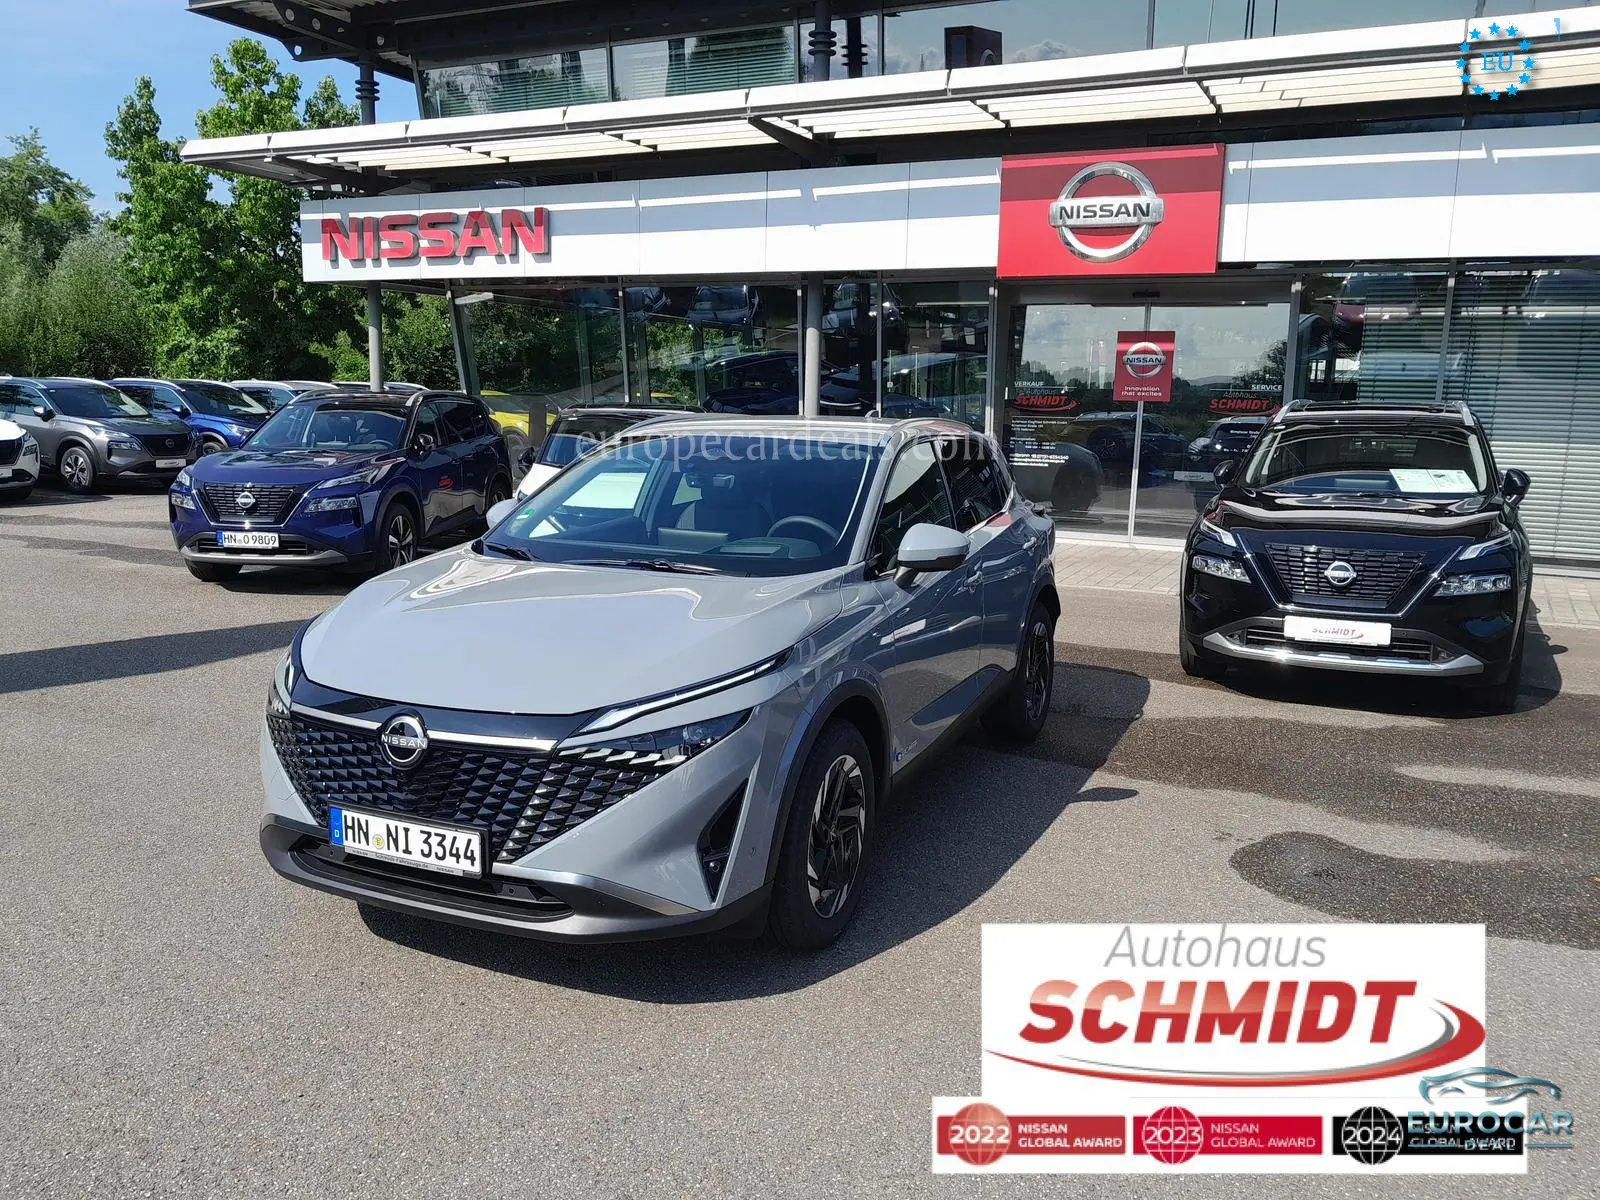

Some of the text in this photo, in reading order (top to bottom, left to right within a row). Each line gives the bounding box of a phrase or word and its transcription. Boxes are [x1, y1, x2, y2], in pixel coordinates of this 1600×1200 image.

[1059, 202, 1151, 220] NISSAN
[321, 206, 549, 262] NISSAN
[1014, 395, 1067, 406] SCHMIDT
[1209, 398, 1269, 410] SCHMIDT
[223, 534, 237, 544] HN
[251, 535, 277, 545] 9809
[381, 734, 426, 748] NISSAN
[334, 829, 340, 838] D
[344, 814, 476, 867] HN NI 3344
